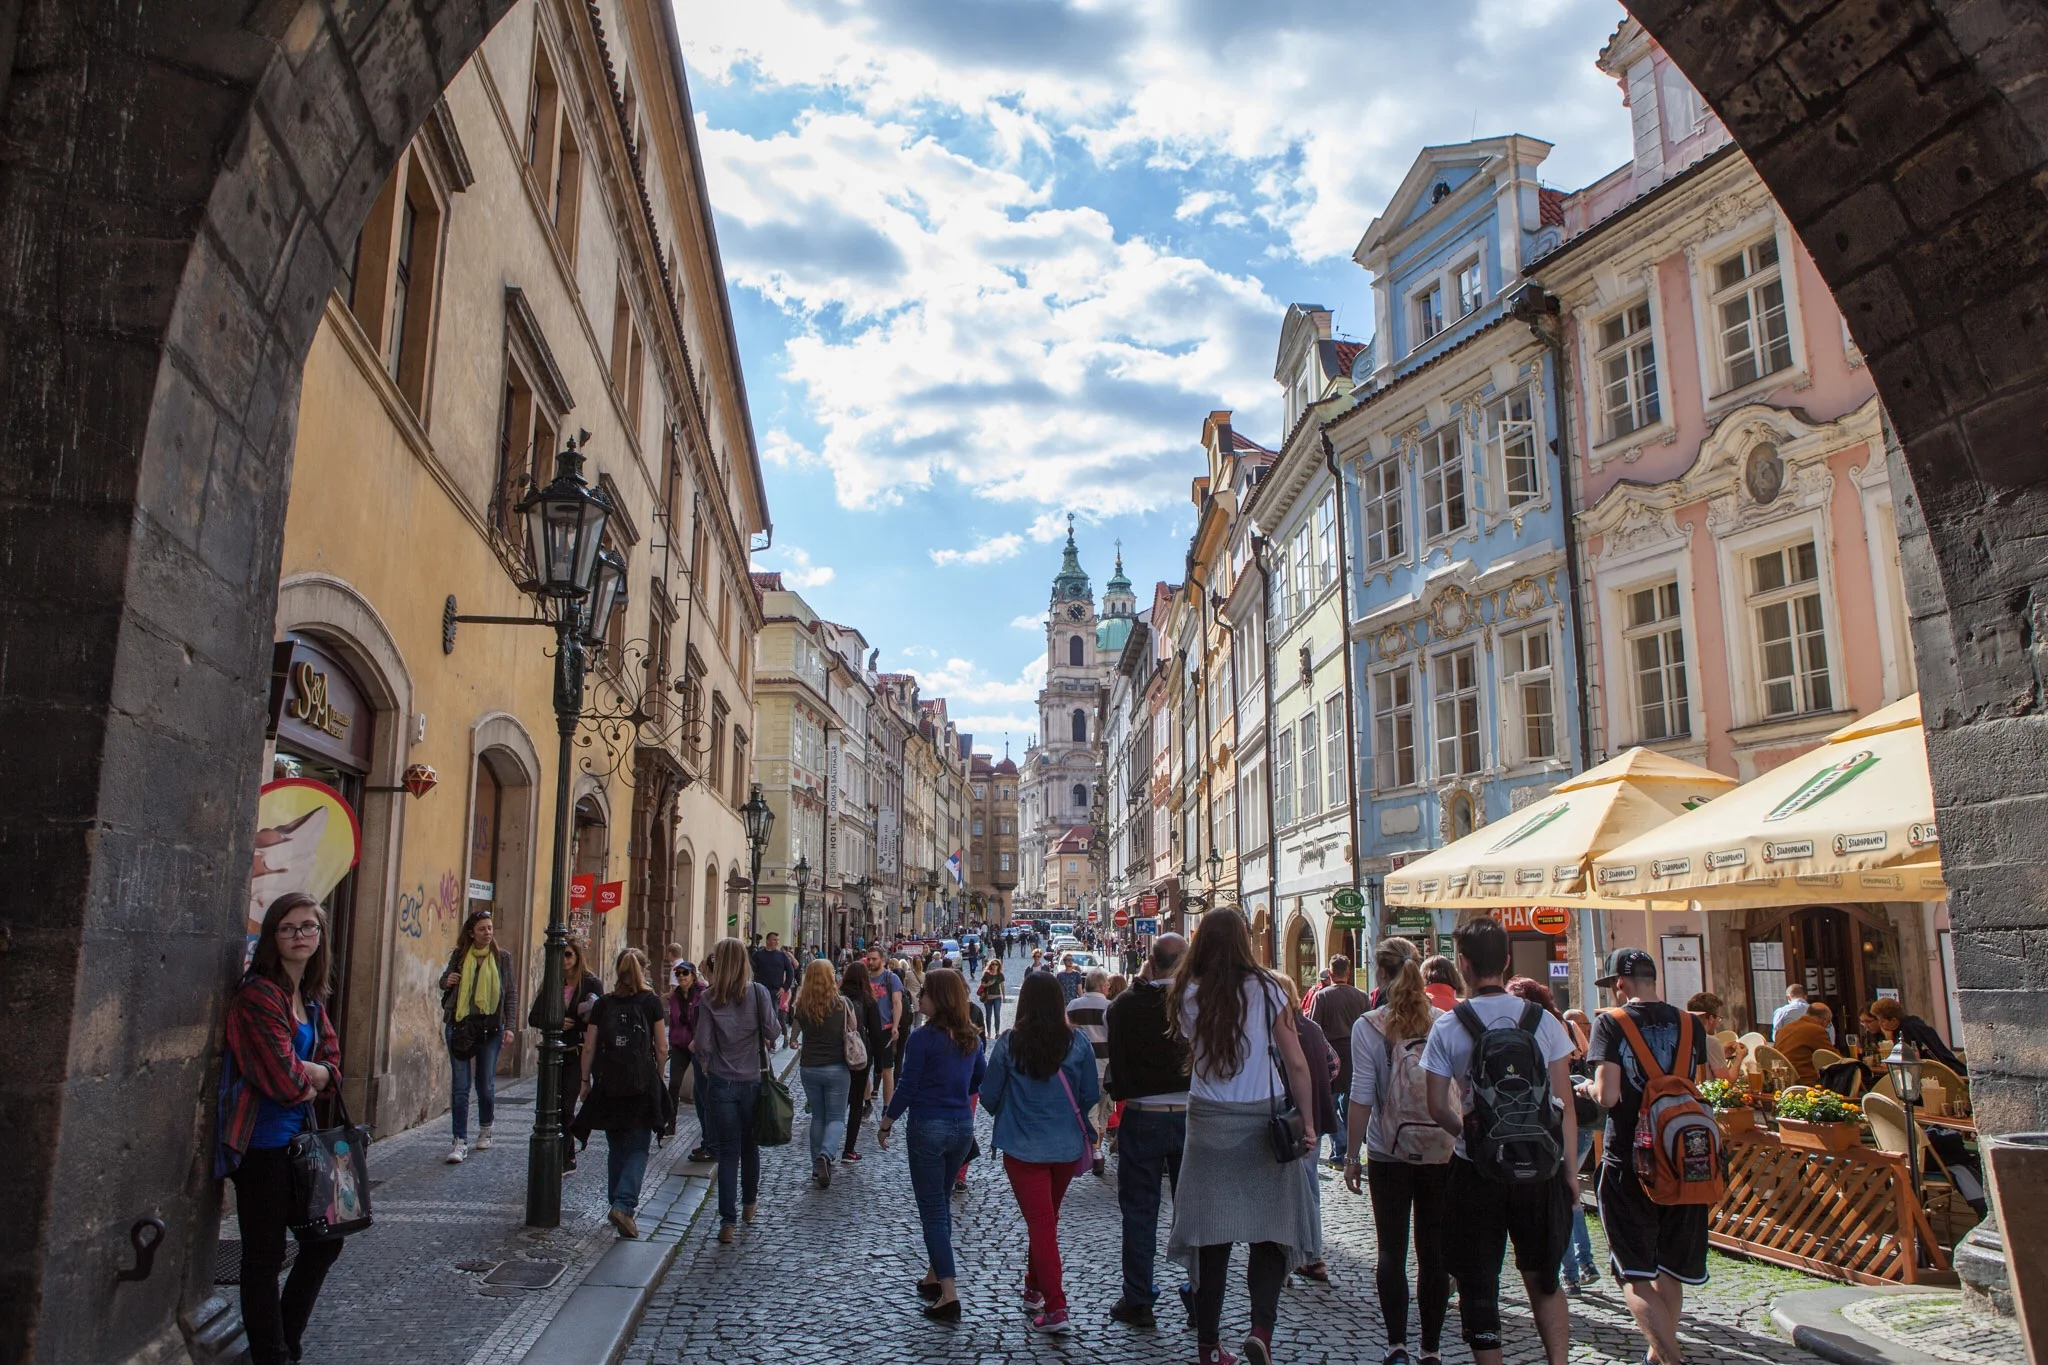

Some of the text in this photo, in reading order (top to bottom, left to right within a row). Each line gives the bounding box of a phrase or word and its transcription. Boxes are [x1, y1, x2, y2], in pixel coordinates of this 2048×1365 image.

[830, 785, 838, 812] DOMUS
[830, 822, 838, 849] HOTEL
[1848, 837, 1883, 849] STAROPRAMEN
[1776, 844, 1811, 856] STAROPRAMEN
[1715, 852, 1743, 864] STAROPRAMEN
[829, 851, 838, 879] DESIGN
[1661, 862, 1688, 873] STAROPRAMEN
[1608, 870, 1634, 879] STAROPRAMEN
